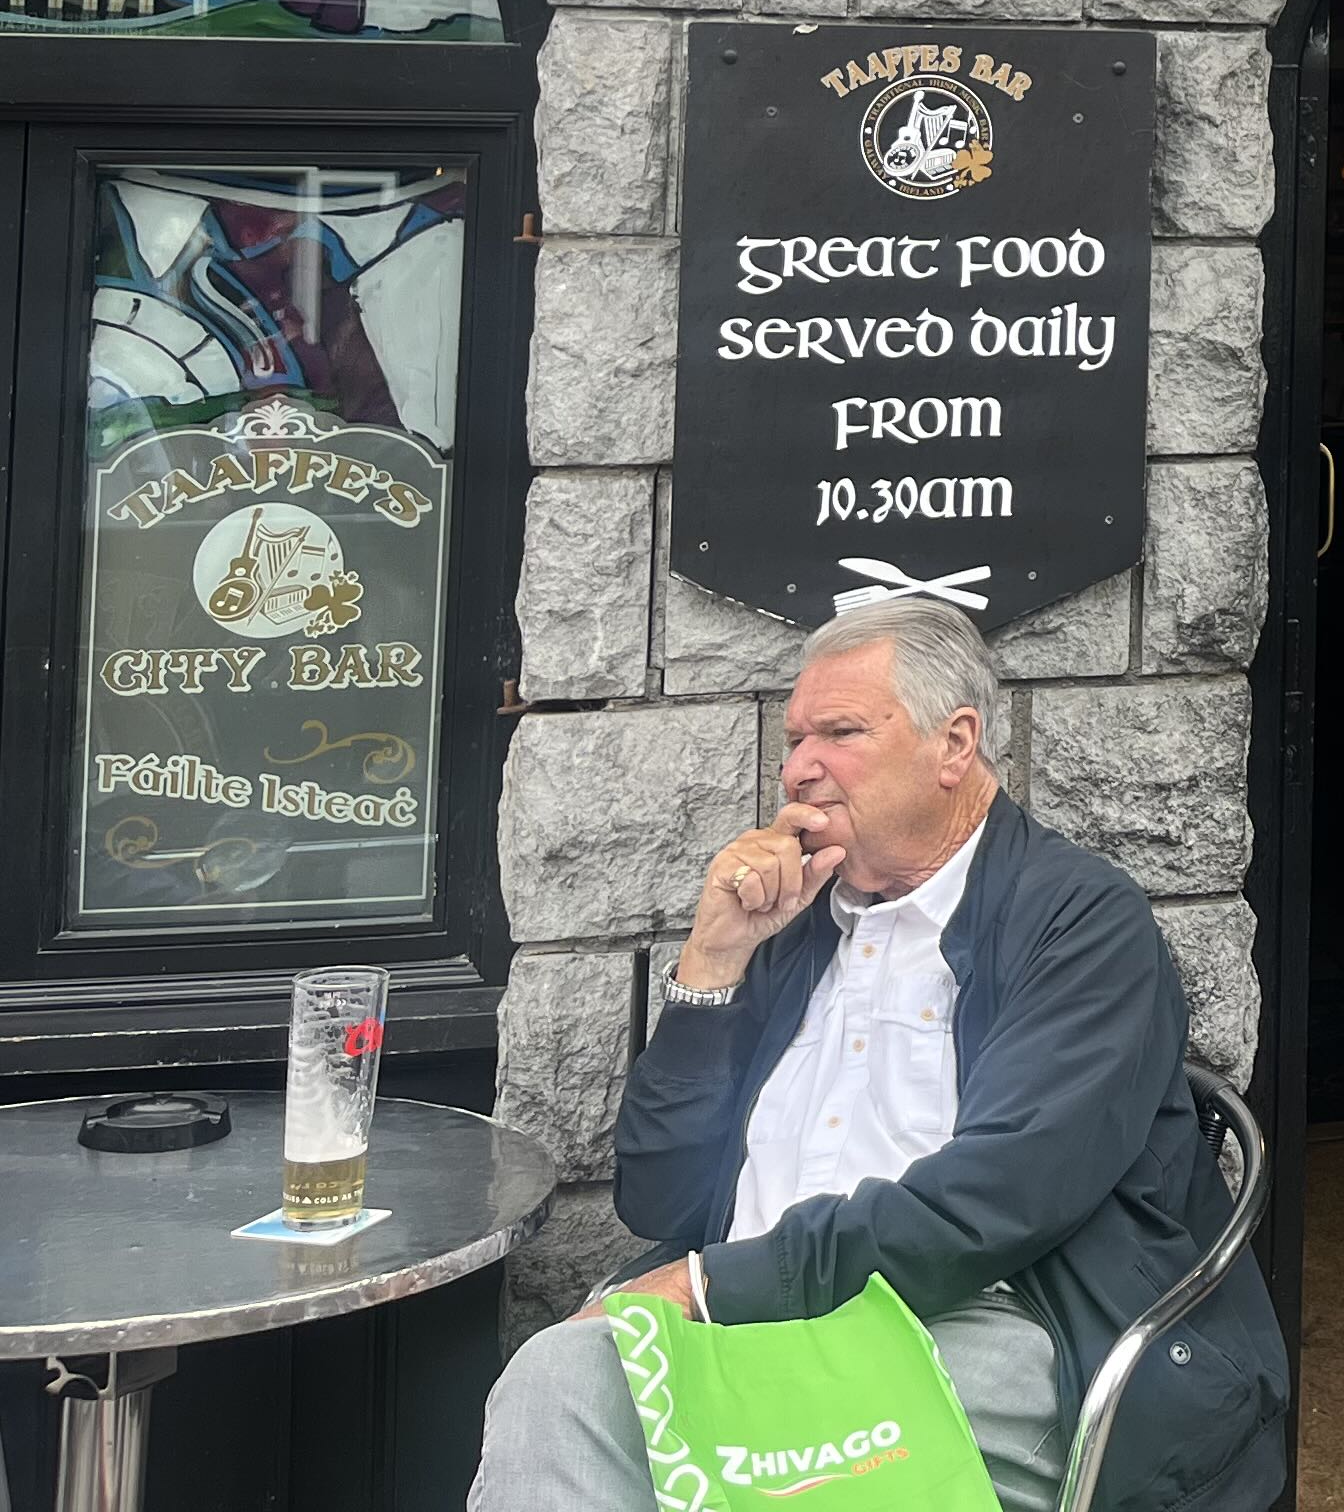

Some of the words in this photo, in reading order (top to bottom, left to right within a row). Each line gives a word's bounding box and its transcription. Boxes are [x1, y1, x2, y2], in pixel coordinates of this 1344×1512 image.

[820, 44, 962, 98] TAAFFES
[968, 54, 1033, 101] BAR
[868, 79, 924, 121] TRADITIONAL
[929, 79, 957, 92] IRISH
[865, 139, 888, 180] GALWAY
[899, 185, 945, 197] IRELAND
[107, 448, 433, 529] TAAFFE'S
[100, 647, 267, 697] CITY
[287, 641, 425, 691] BAR
[95, 753, 252, 808] Fáilte
[314, 1195, 339, 1205] COLD
[715, 1420, 901, 1485] ZHIVAGO
[852, 1446, 910, 1476] GIFTS
